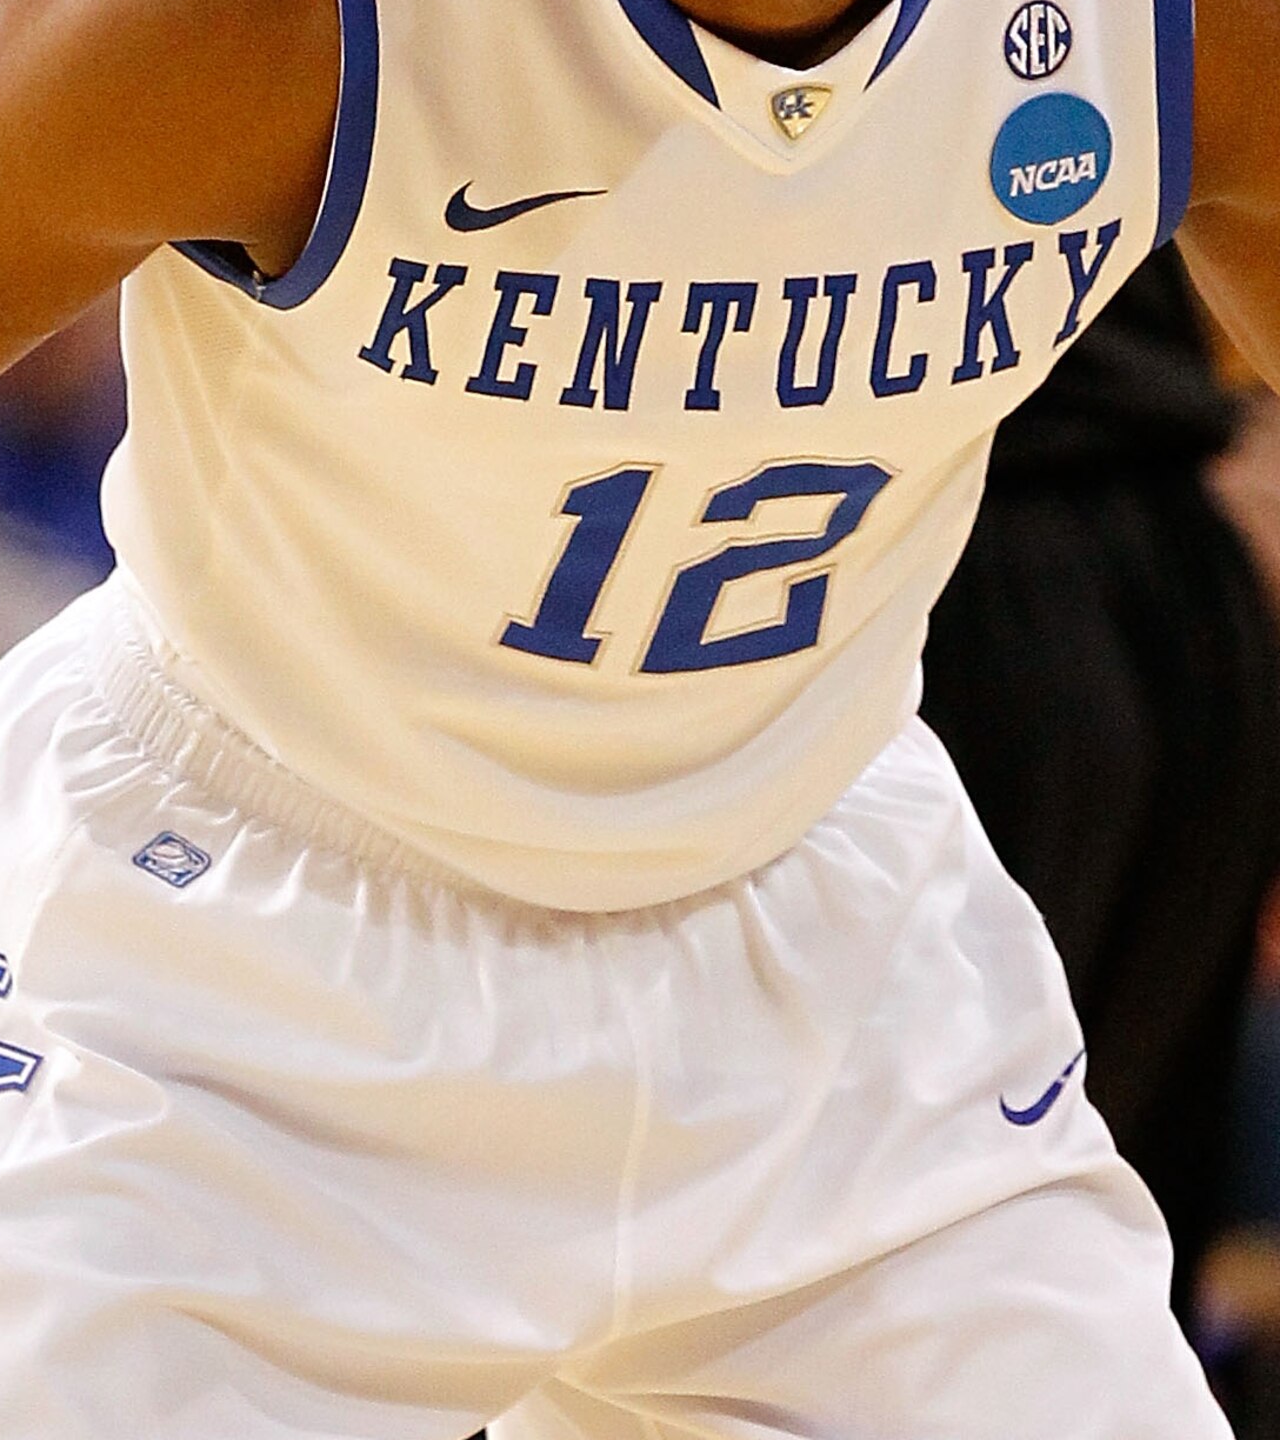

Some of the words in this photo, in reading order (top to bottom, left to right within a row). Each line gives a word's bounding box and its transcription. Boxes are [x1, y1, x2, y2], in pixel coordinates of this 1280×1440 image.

[1007, 2, 1069, 77] SEC
[1009, 152, 1097, 197] NCAA
[357, 219, 1121, 411] KENTUCKY
[493, 456, 903, 676] 12
